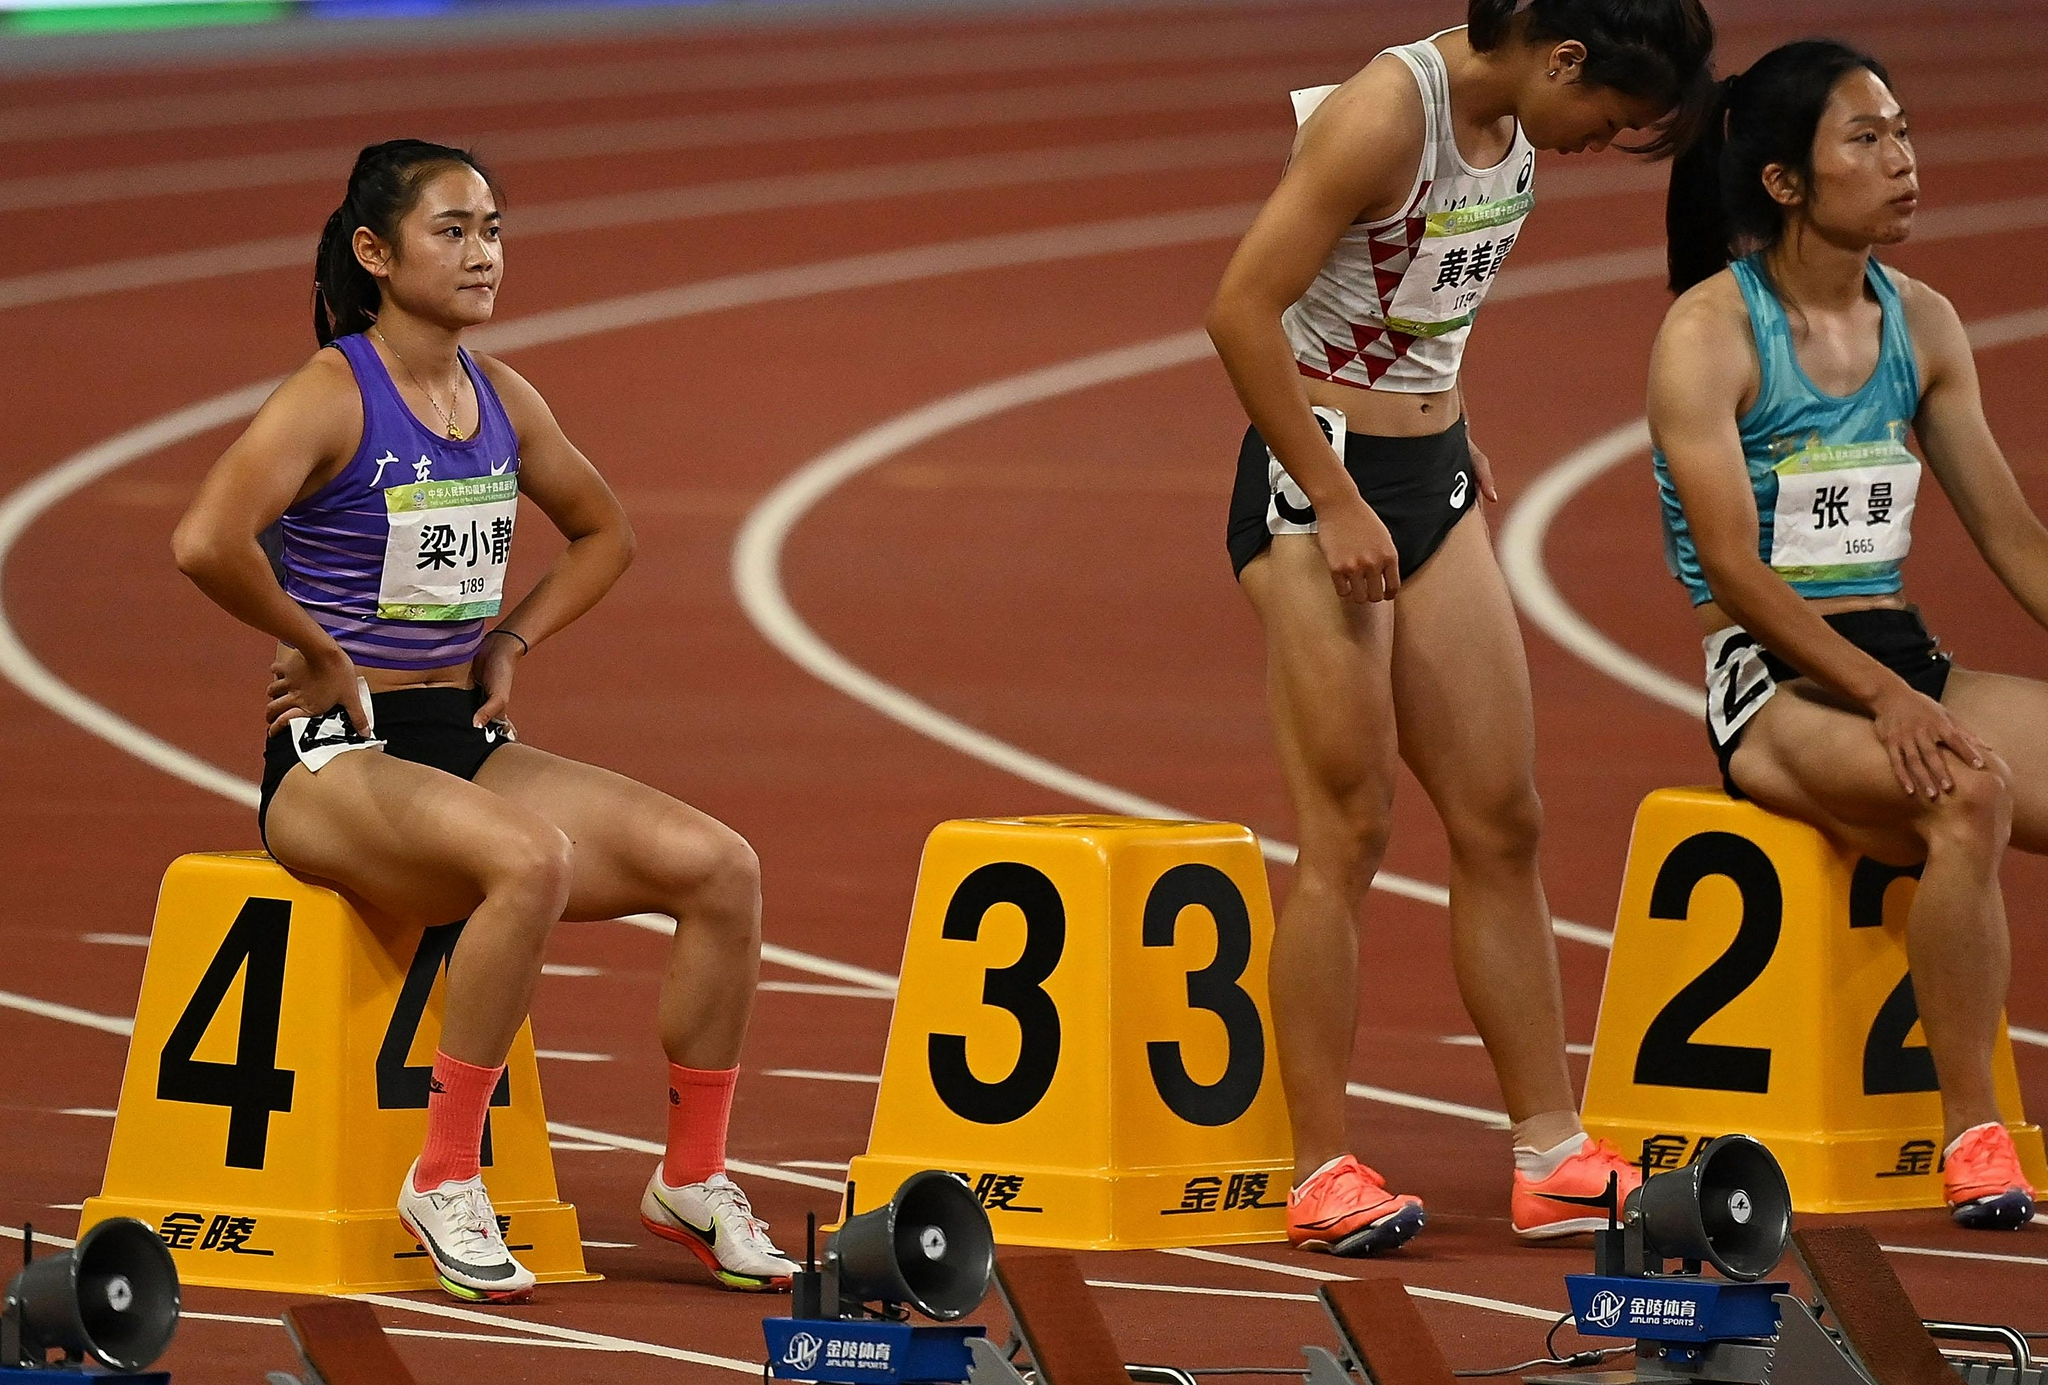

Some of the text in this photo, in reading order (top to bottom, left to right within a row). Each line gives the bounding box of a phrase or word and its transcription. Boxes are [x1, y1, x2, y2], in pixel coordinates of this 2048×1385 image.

[1845, 538, 1875, 554] 1665
[1714, 632, 1769, 727] 2
[1633, 831, 1784, 1095] 2
[928, 861, 1066, 1125] 3
[1143, 863, 1265, 1127] 3
[157, 896, 295, 1170] 4
[1629, 1134, 1715, 1169] 金
[1875, 1139, 1945, 1178] 金
[948, 1171, 1043, 1213] 陵
[1160, 1173, 1288, 1215] 金陵
[159, 1212, 274, 1256] 金陵
[1629, 1297, 1697, 1318] 金陵体育
[1629, 1316, 1694, 1327] JINLING SPORTS
[825, 1339, 892, 1361] 金陵体育
